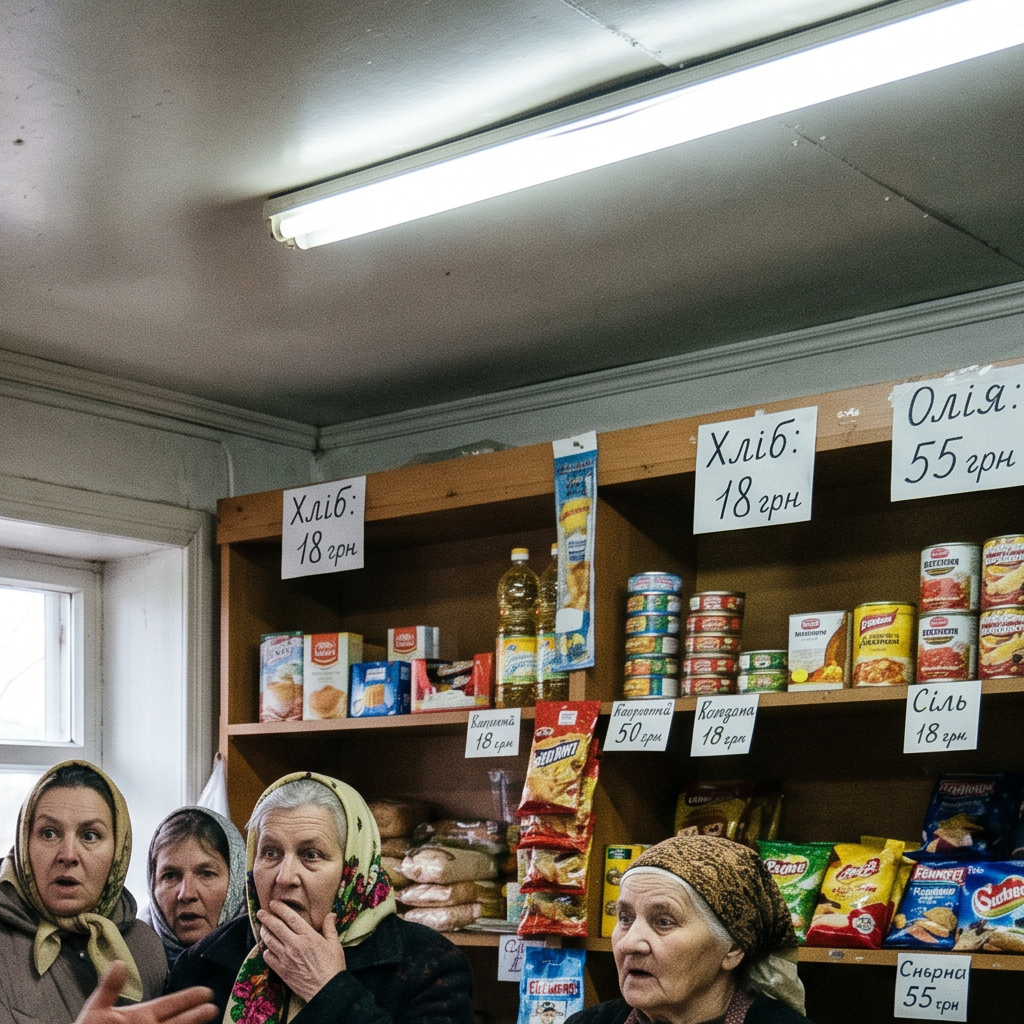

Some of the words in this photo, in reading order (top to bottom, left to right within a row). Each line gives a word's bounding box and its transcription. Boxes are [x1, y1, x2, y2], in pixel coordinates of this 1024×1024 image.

[908, 384, 1021, 426] Олія:
[706, 418, 800, 468] Хліб:
[904, 436, 963, 483] 55
[966, 450, 1016, 483] грн
[290, 485, 356, 525] Хліб:
[715, 476, 752, 519] 18
[758, 492, 802, 521] грн
[296, 531, 322, 564] 18
[327, 542, 357, 567] грн
[913, 688, 967, 713] Сіль
[476, 732, 493, 750] 18
[615, 722, 642, 743] 50
[702, 725, 724, 745] 18
[916, 723, 939, 744] 18
[903, 986, 936, 1008] 55
